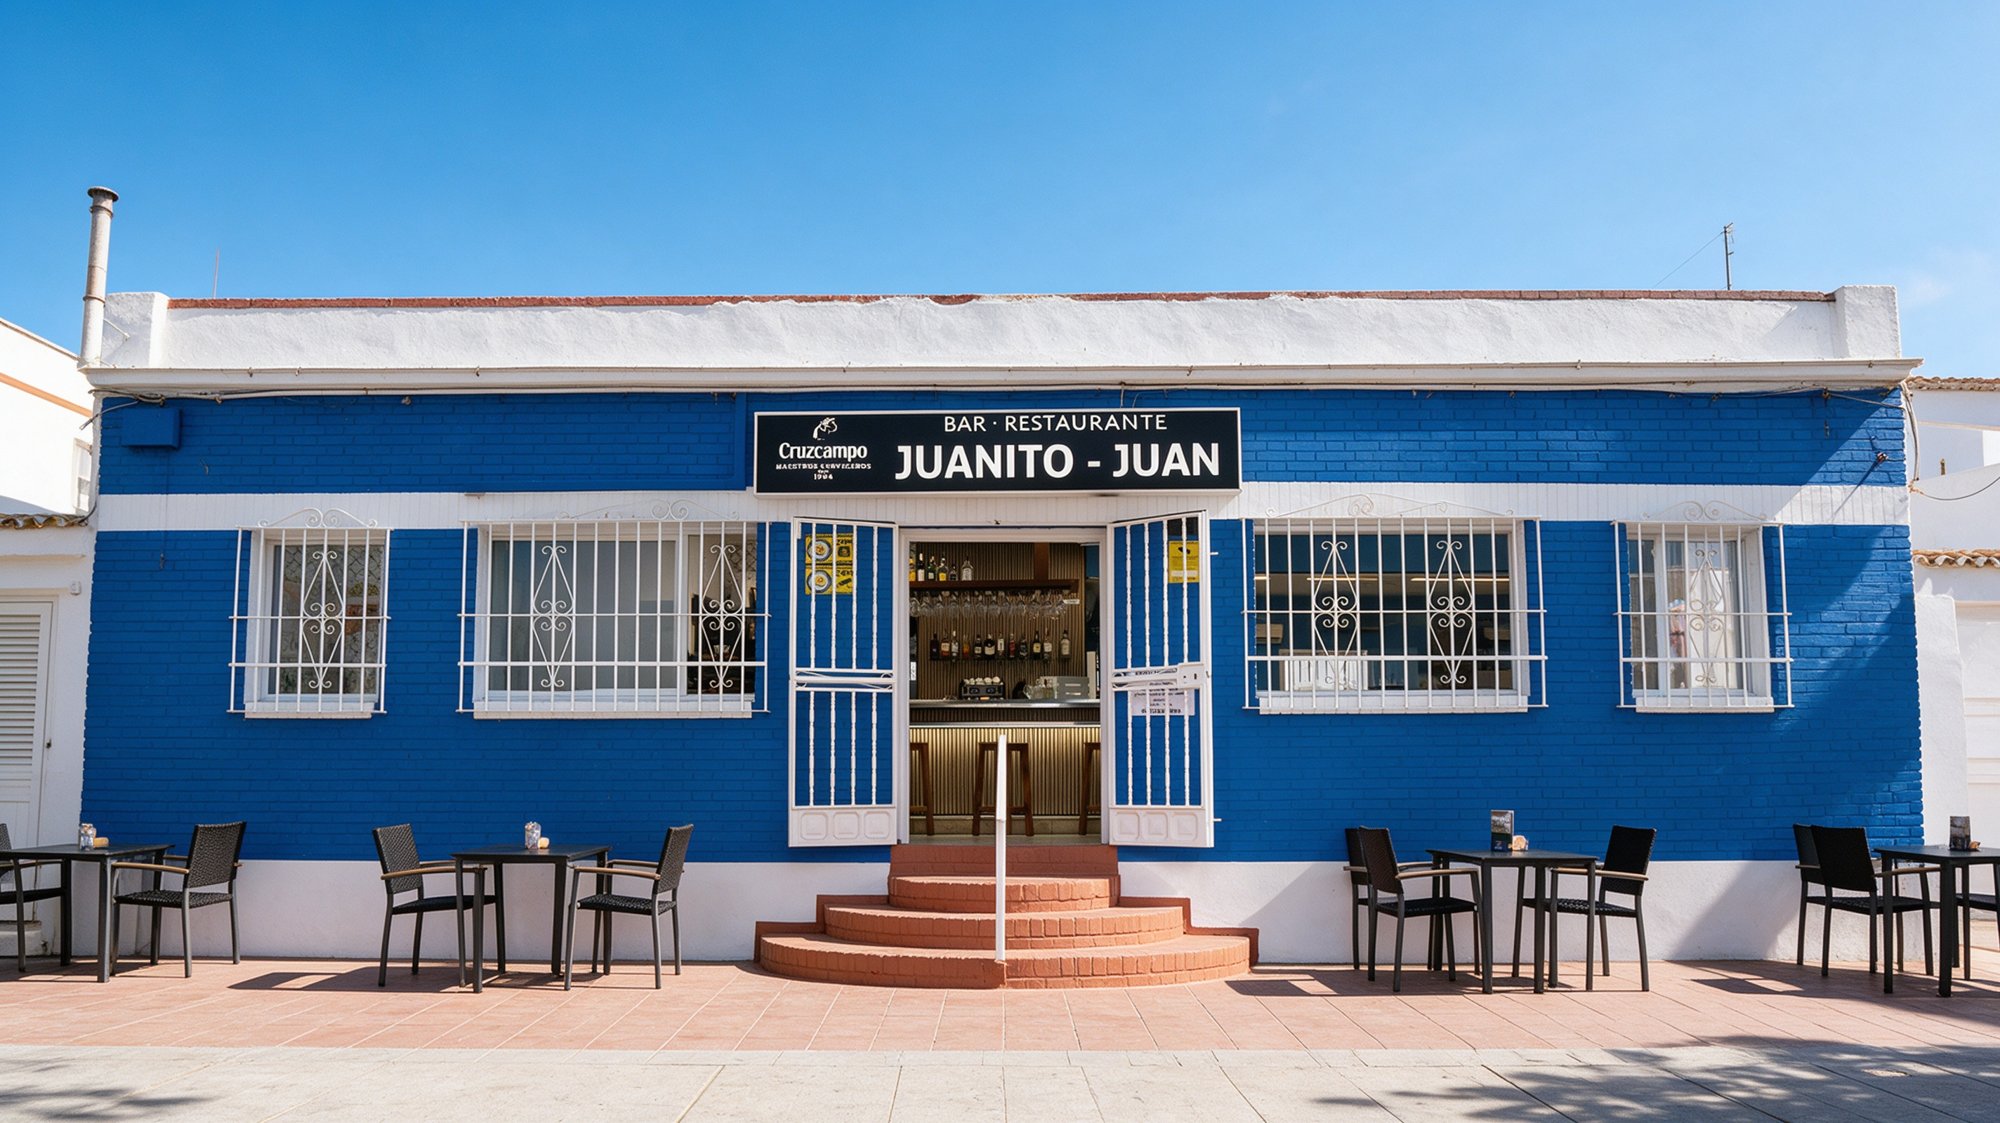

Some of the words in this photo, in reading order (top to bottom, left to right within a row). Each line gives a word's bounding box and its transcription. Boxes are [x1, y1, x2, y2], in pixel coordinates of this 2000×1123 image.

[944, 415, 987, 433] BAR
[1005, 414, 1168, 432] RESTAURANTE
[778, 442, 868, 463] Cruzcampo
[894, 443, 1074, 480] JUANITO
[1087, 460, 1101, 468] -
[1112, 442, 1220, 478] JUAN
